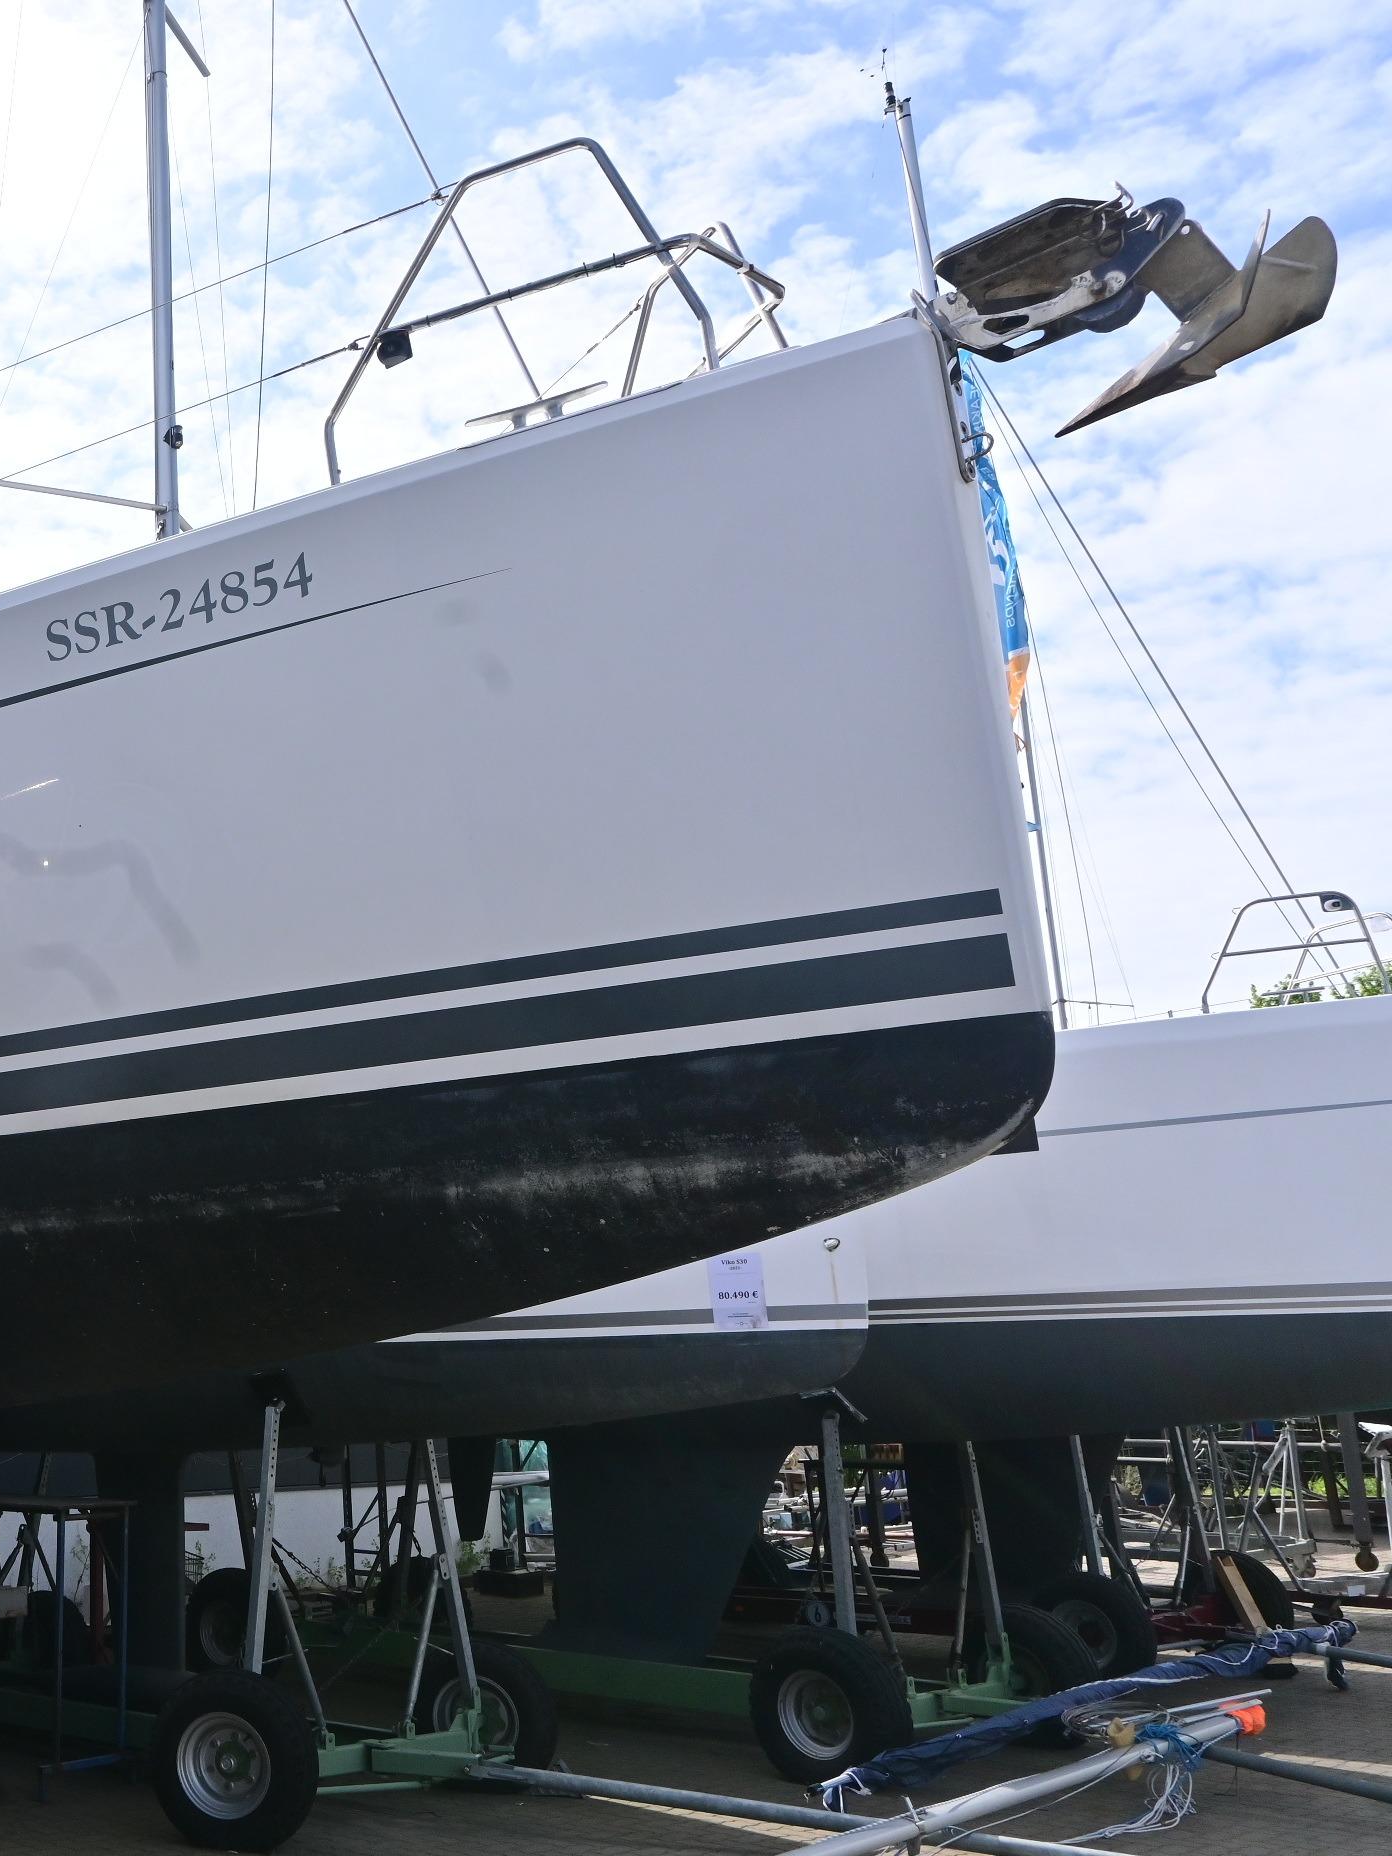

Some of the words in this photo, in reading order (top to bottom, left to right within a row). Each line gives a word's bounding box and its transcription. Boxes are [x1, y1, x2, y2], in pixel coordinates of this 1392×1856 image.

[46, 552, 313, 662] SSR-24854
[718, 1290, 750, 1300] 80.490
[752, 1290, 759, 1299] €
[814, 1606, 821, 1622] 6
